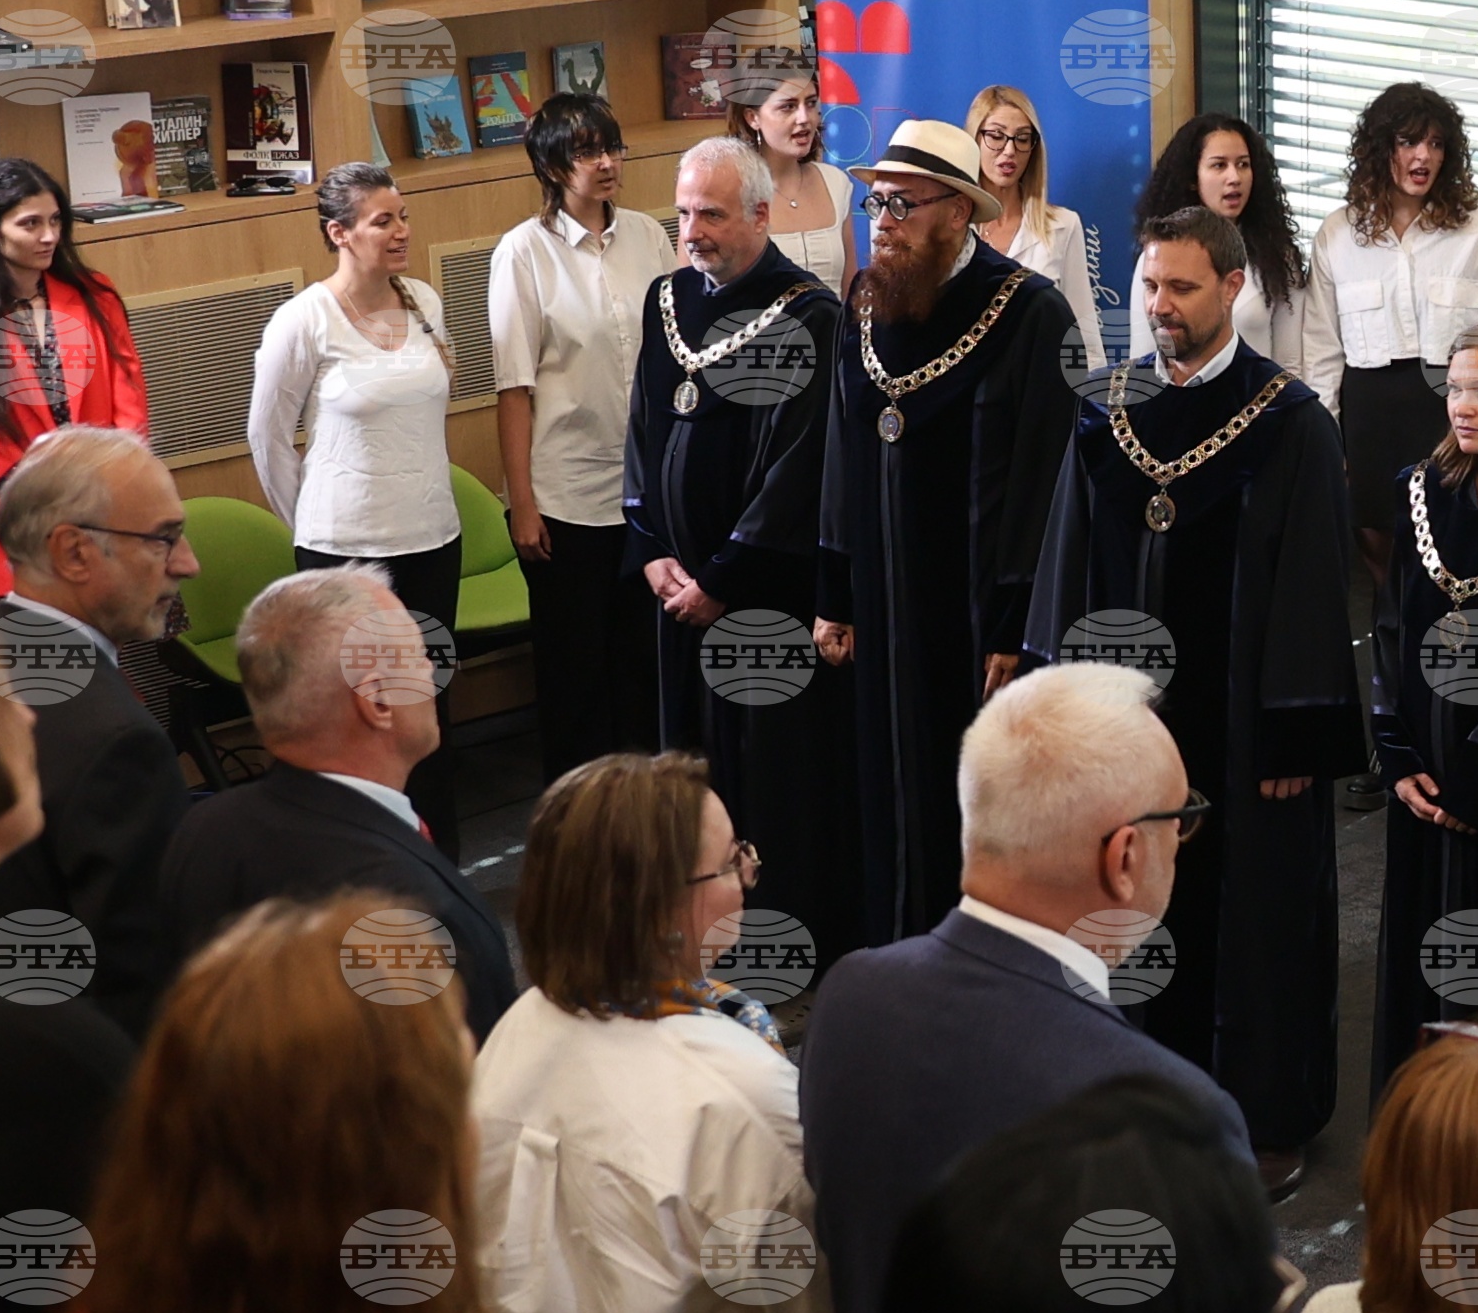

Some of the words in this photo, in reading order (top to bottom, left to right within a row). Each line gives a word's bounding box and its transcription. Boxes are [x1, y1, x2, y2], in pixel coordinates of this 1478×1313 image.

[152, 115, 202, 132] СТАЛИН
[486, 113, 526, 126] POLITICS
[153, 127, 202, 144] ХИТЛЕР
[243, 150, 270, 160] ФОЛК
[271, 150, 300, 160] ДЖАЗ
[258, 161, 283, 169] СКАТ
